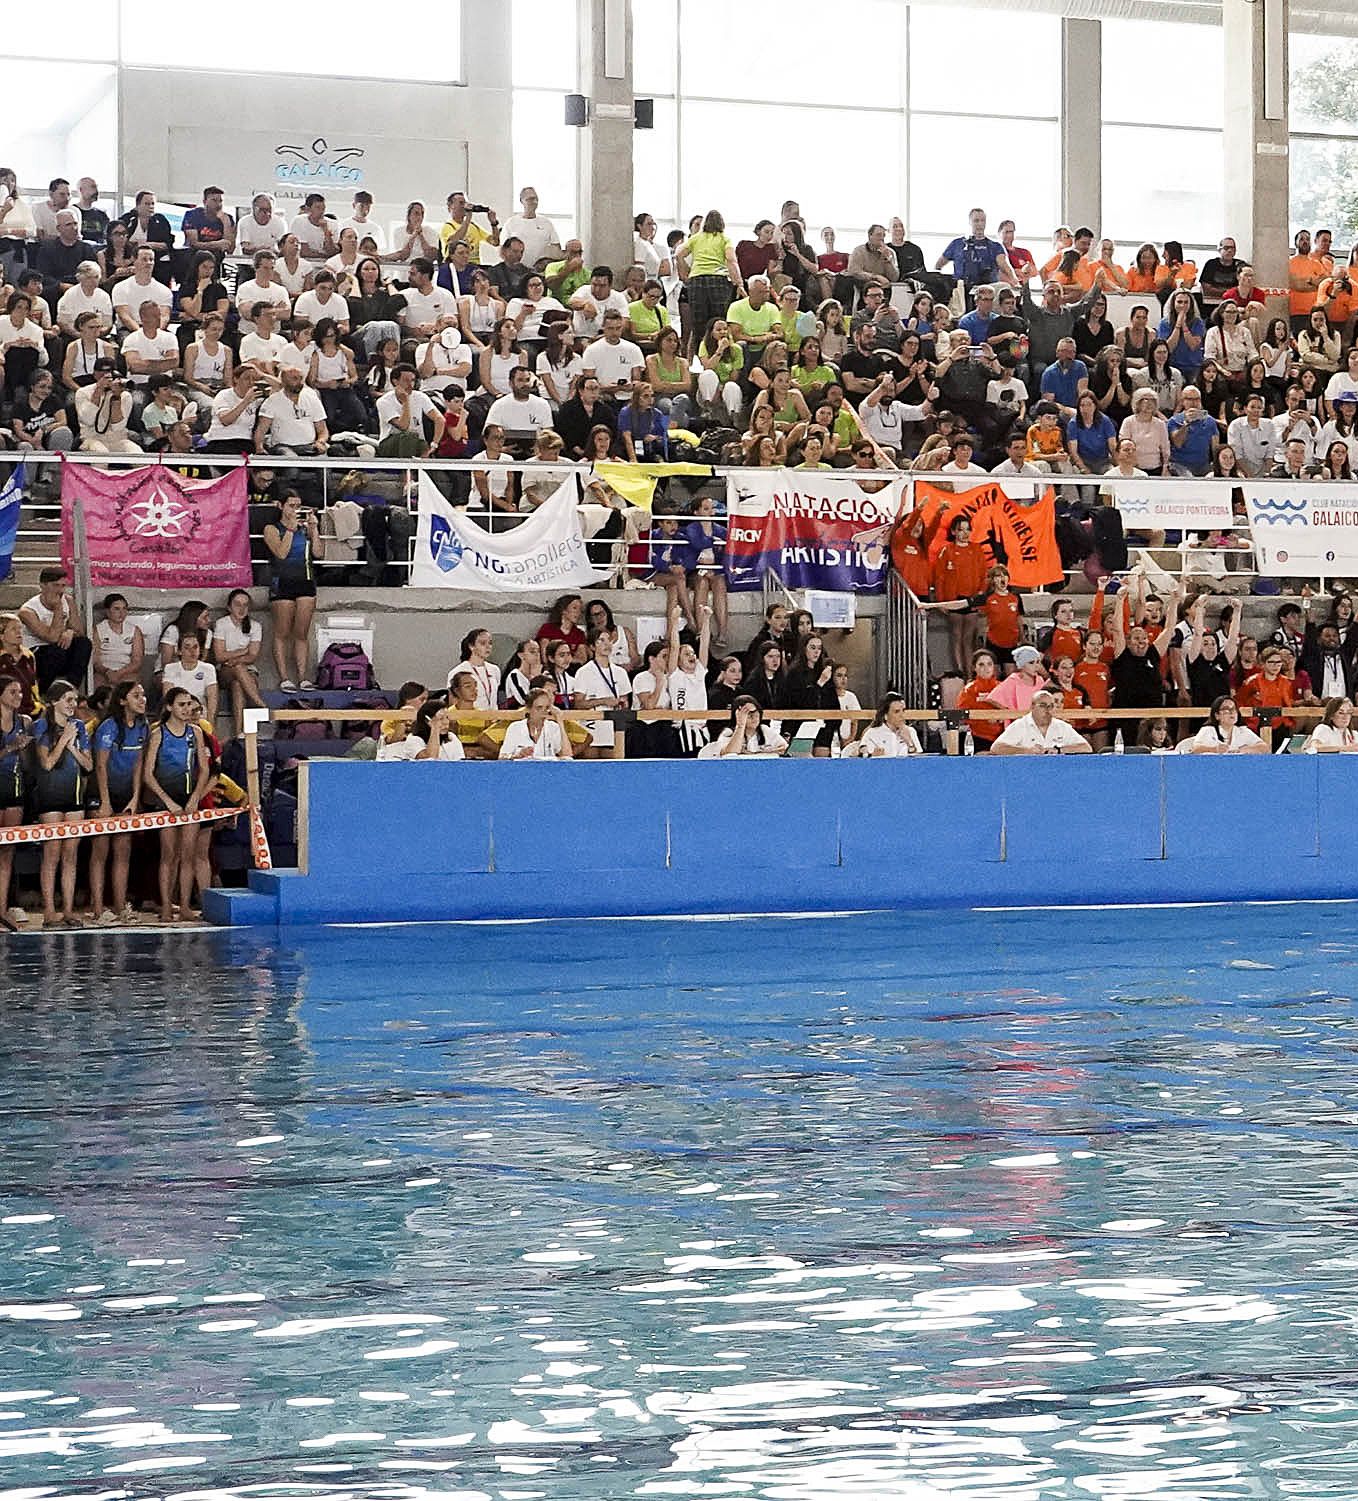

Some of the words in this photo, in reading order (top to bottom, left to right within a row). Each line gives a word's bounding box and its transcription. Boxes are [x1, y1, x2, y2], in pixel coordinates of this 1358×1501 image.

[275, 163, 363, 182] GALAICO
[1313, 511, 1358, 526] GALAICO
[1003, 501, 1037, 564] OURENSE
